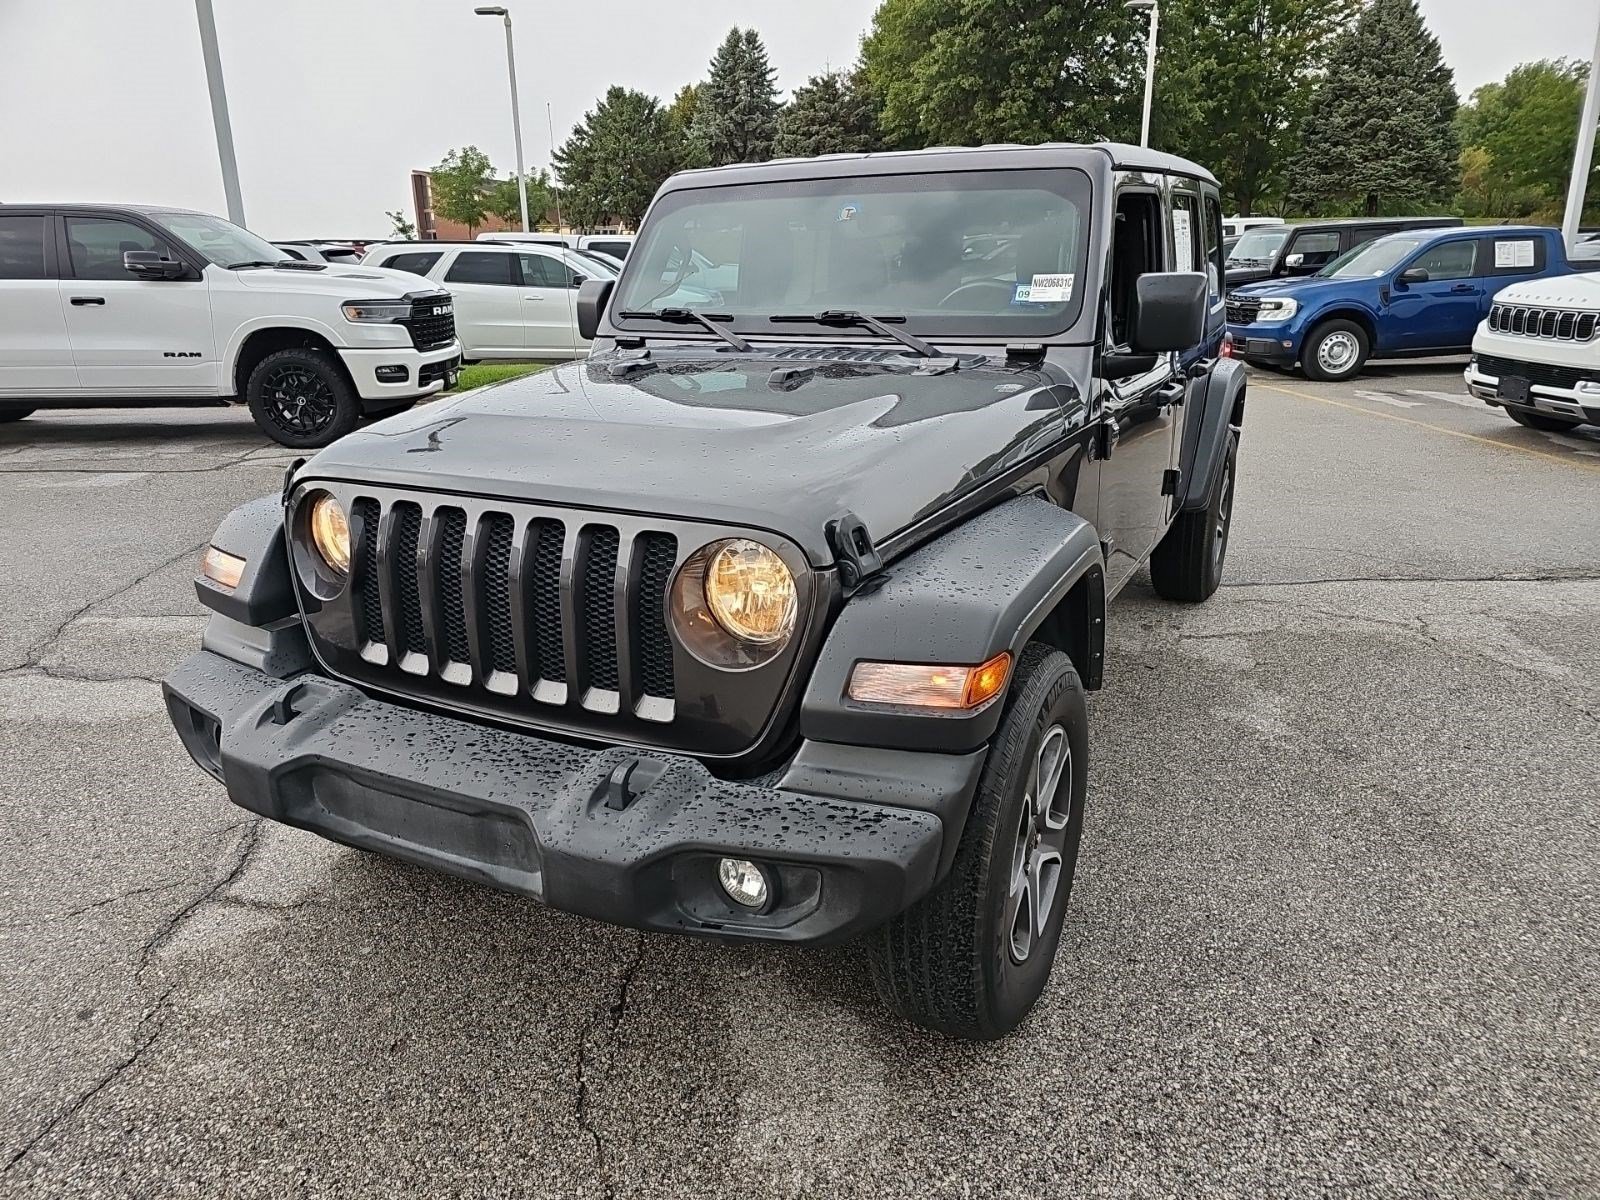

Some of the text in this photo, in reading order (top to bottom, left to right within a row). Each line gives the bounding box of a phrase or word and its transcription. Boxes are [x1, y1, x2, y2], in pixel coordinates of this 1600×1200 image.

[1032, 277, 1073, 288] NW206831C
[1017, 290, 1030, 299] 09
[432, 305, 453, 316] RAM
